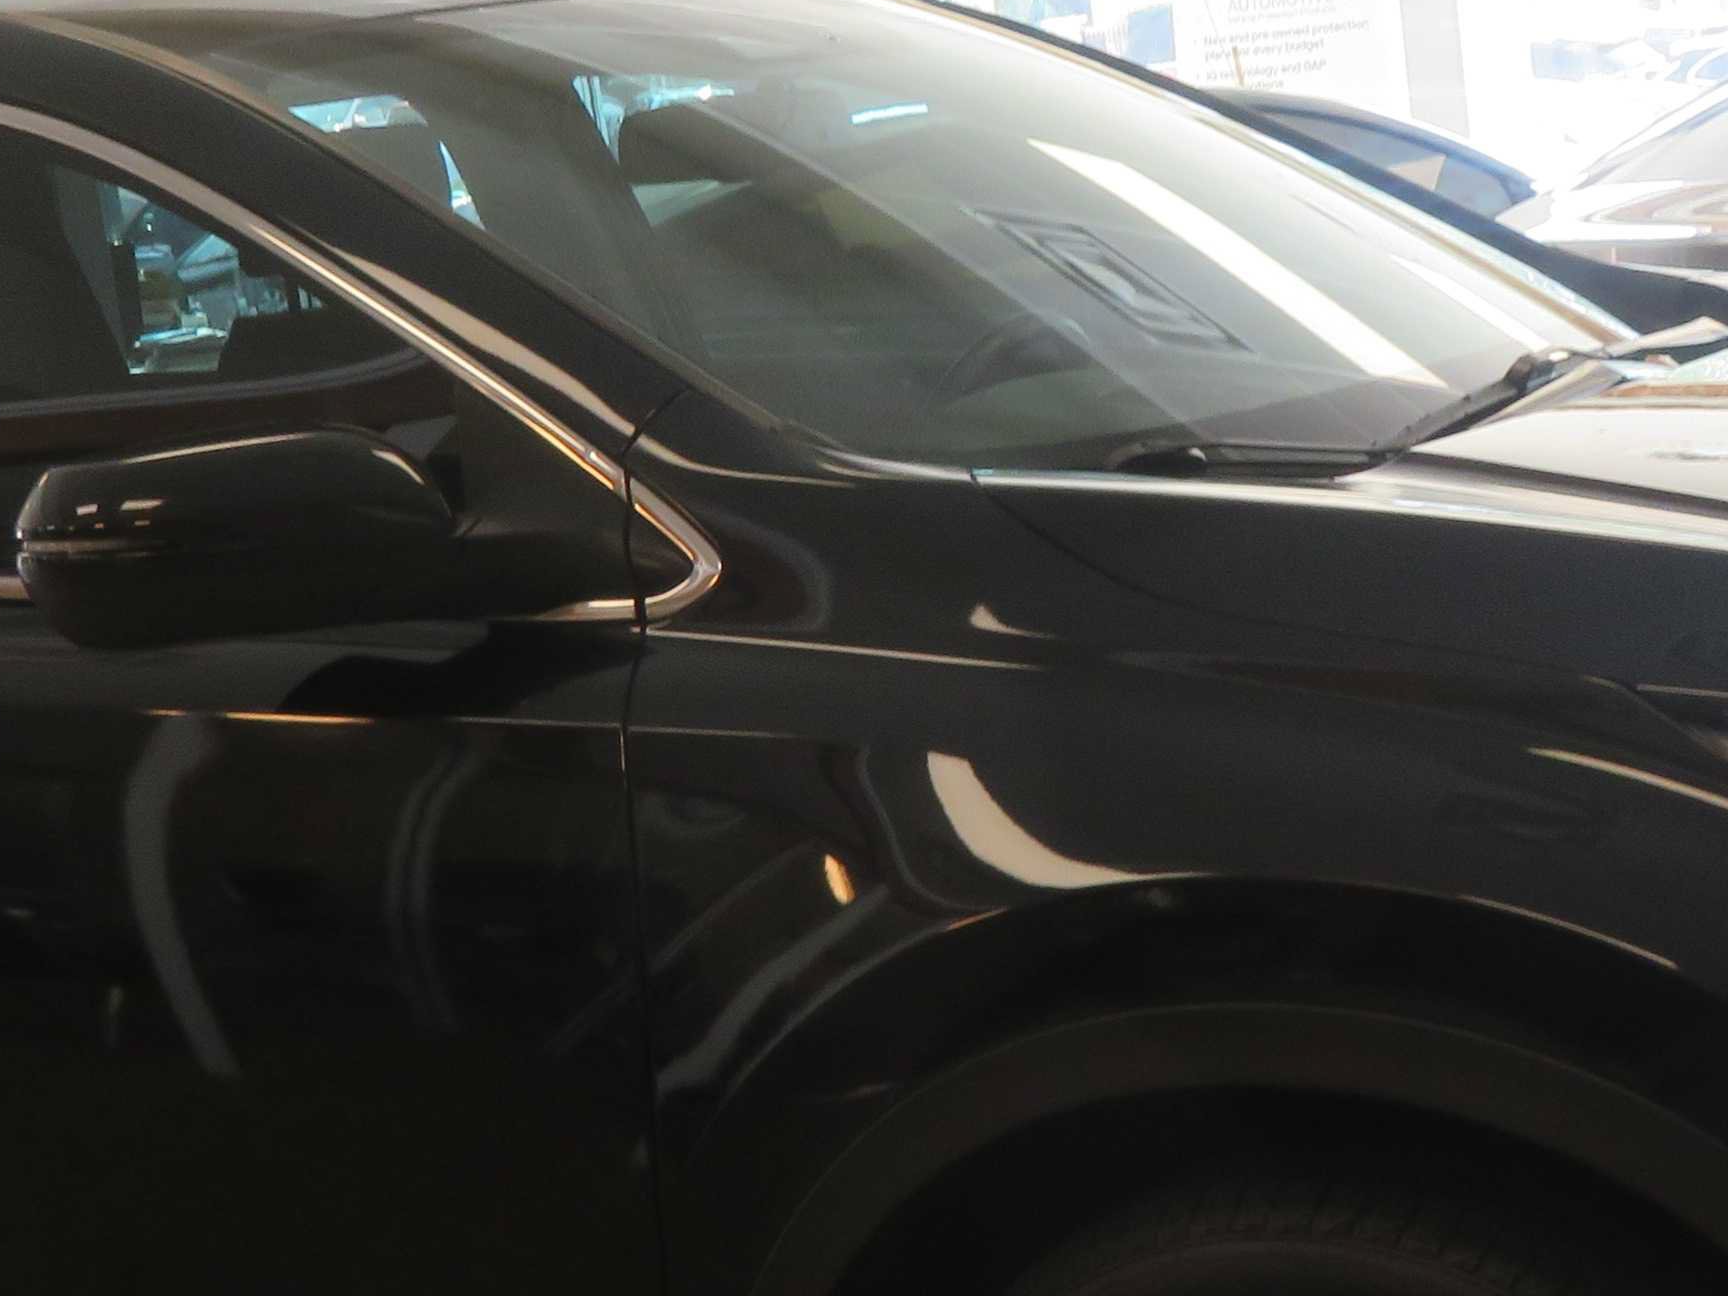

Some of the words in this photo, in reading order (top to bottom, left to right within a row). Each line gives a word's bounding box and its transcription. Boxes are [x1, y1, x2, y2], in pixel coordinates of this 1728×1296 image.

[1312, 18, 1369, 37] protection
[1252, 44, 1283, 58] every
[1284, 37, 1325, 55] budget
[1281, 61, 1302, 74] and
[1304, 57, 1327, 73] GAP
